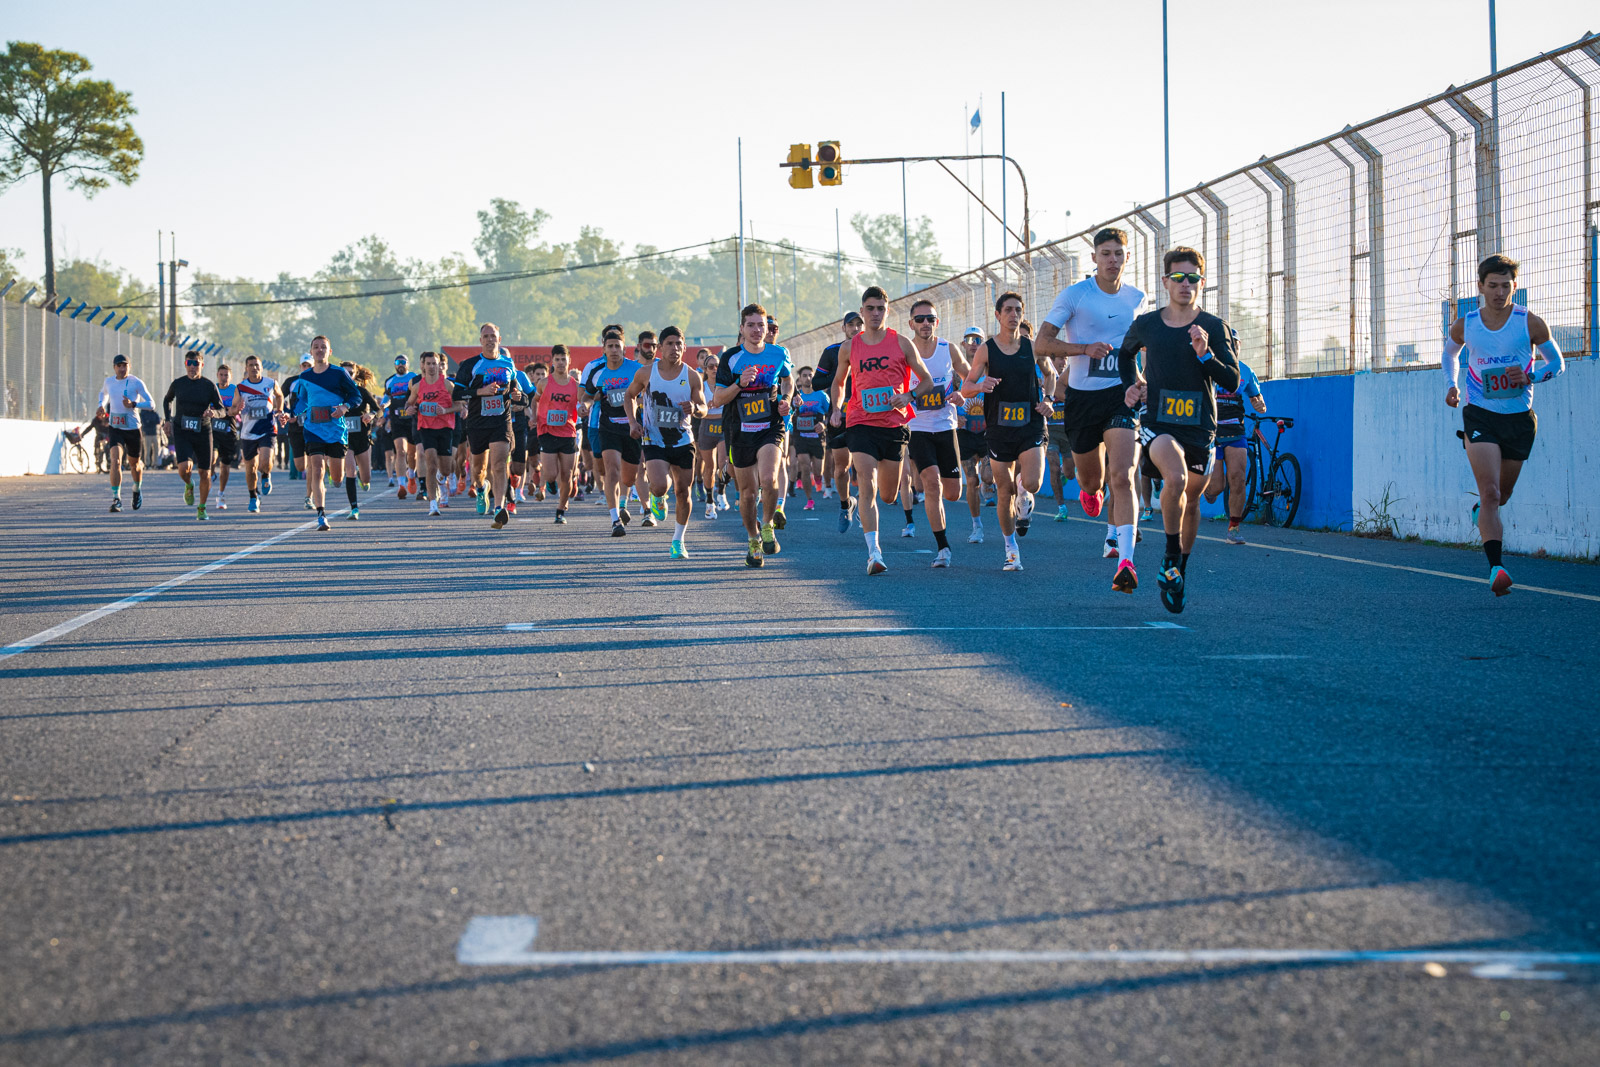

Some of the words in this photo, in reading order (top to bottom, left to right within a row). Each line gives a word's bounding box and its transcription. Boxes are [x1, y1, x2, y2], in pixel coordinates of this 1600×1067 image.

[859, 356, 889, 373] KRC
[1477, 355, 1520, 365] RUNNEA
[550, 393, 571, 403] KRC
[867, 392, 888, 407] 313
[922, 392, 942, 407] 744
[422, 405, 435, 413] 316
[485, 399, 501, 410] 359
[744, 399, 765, 416] 707
[1166, 397, 1194, 416] 706
[251, 409, 264, 417] 144
[550, 413, 564, 422] 305
[659, 410, 679, 423] 174
[1003, 407, 1025, 420] 718
[185, 420, 198, 429] 167
[214, 420, 226, 430] 140
[708, 424, 723, 434] 616
